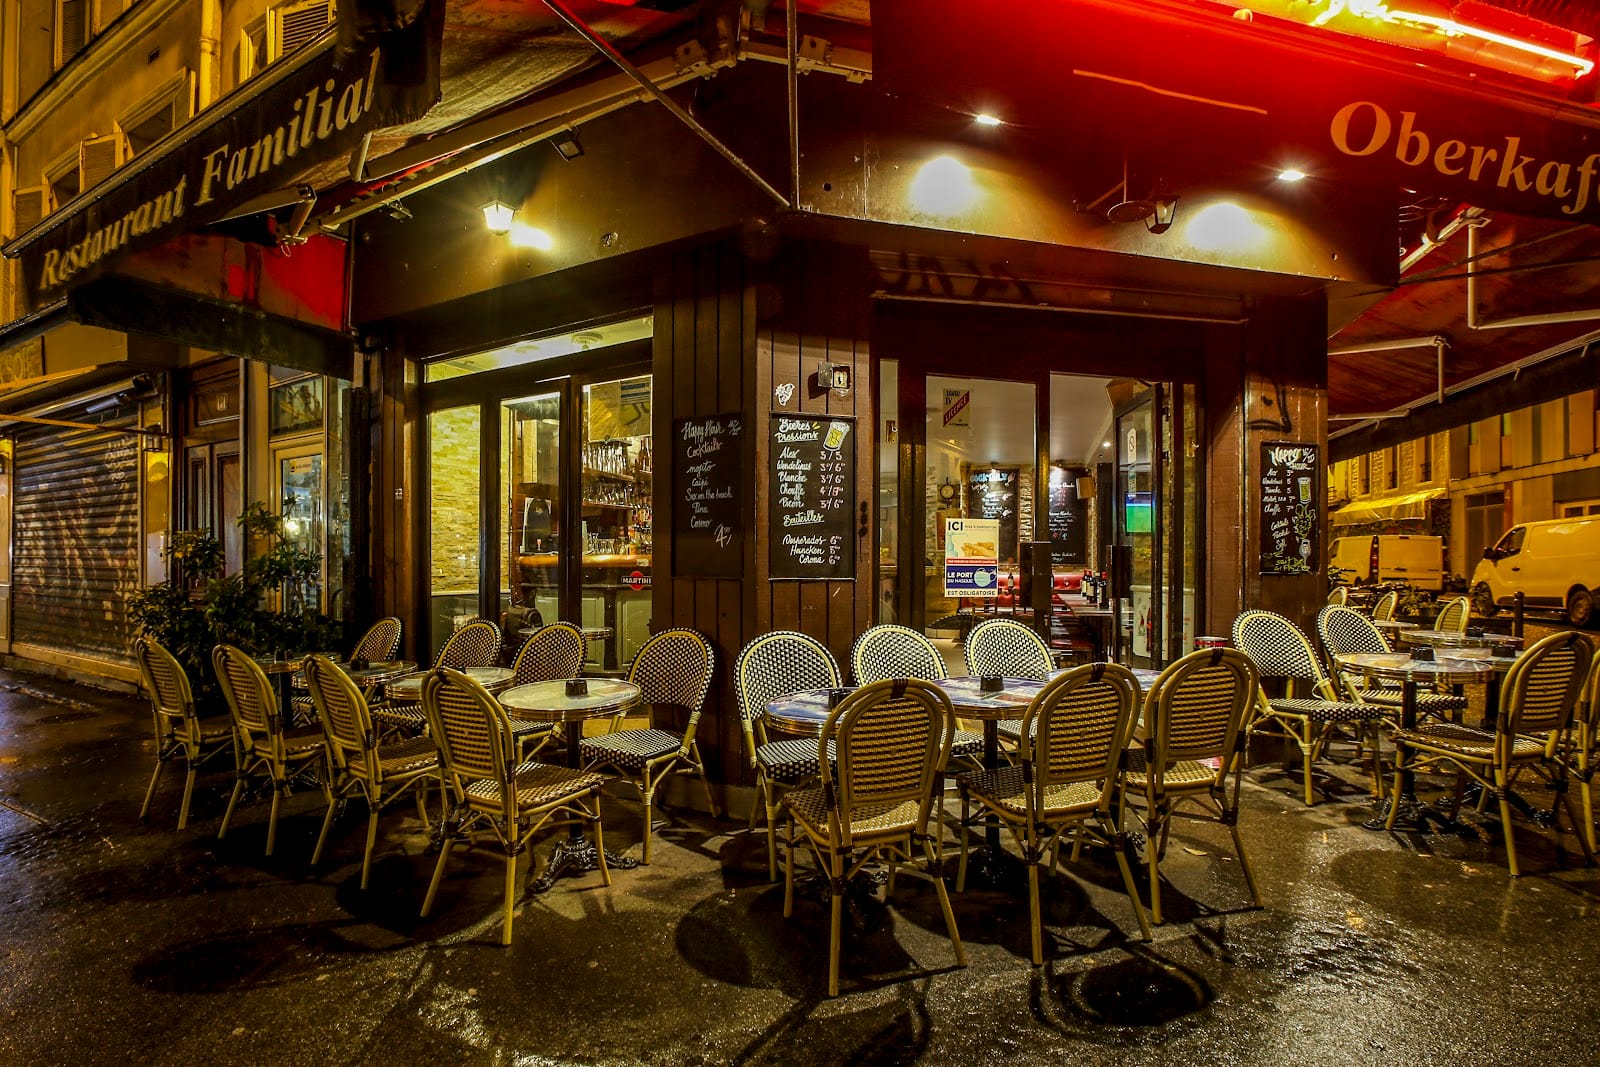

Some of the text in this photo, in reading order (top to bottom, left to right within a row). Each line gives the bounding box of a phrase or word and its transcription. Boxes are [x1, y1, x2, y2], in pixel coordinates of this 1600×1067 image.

[40, 47, 381, 290] Restaurant Familial
[1330, 101, 1600, 215] Oberkaf
[944, 395, 968, 422] LICENCE
[681, 421, 704, 445] Happy
[686, 437, 724, 458] Cocktails
[948, 521, 963, 531] ICI
